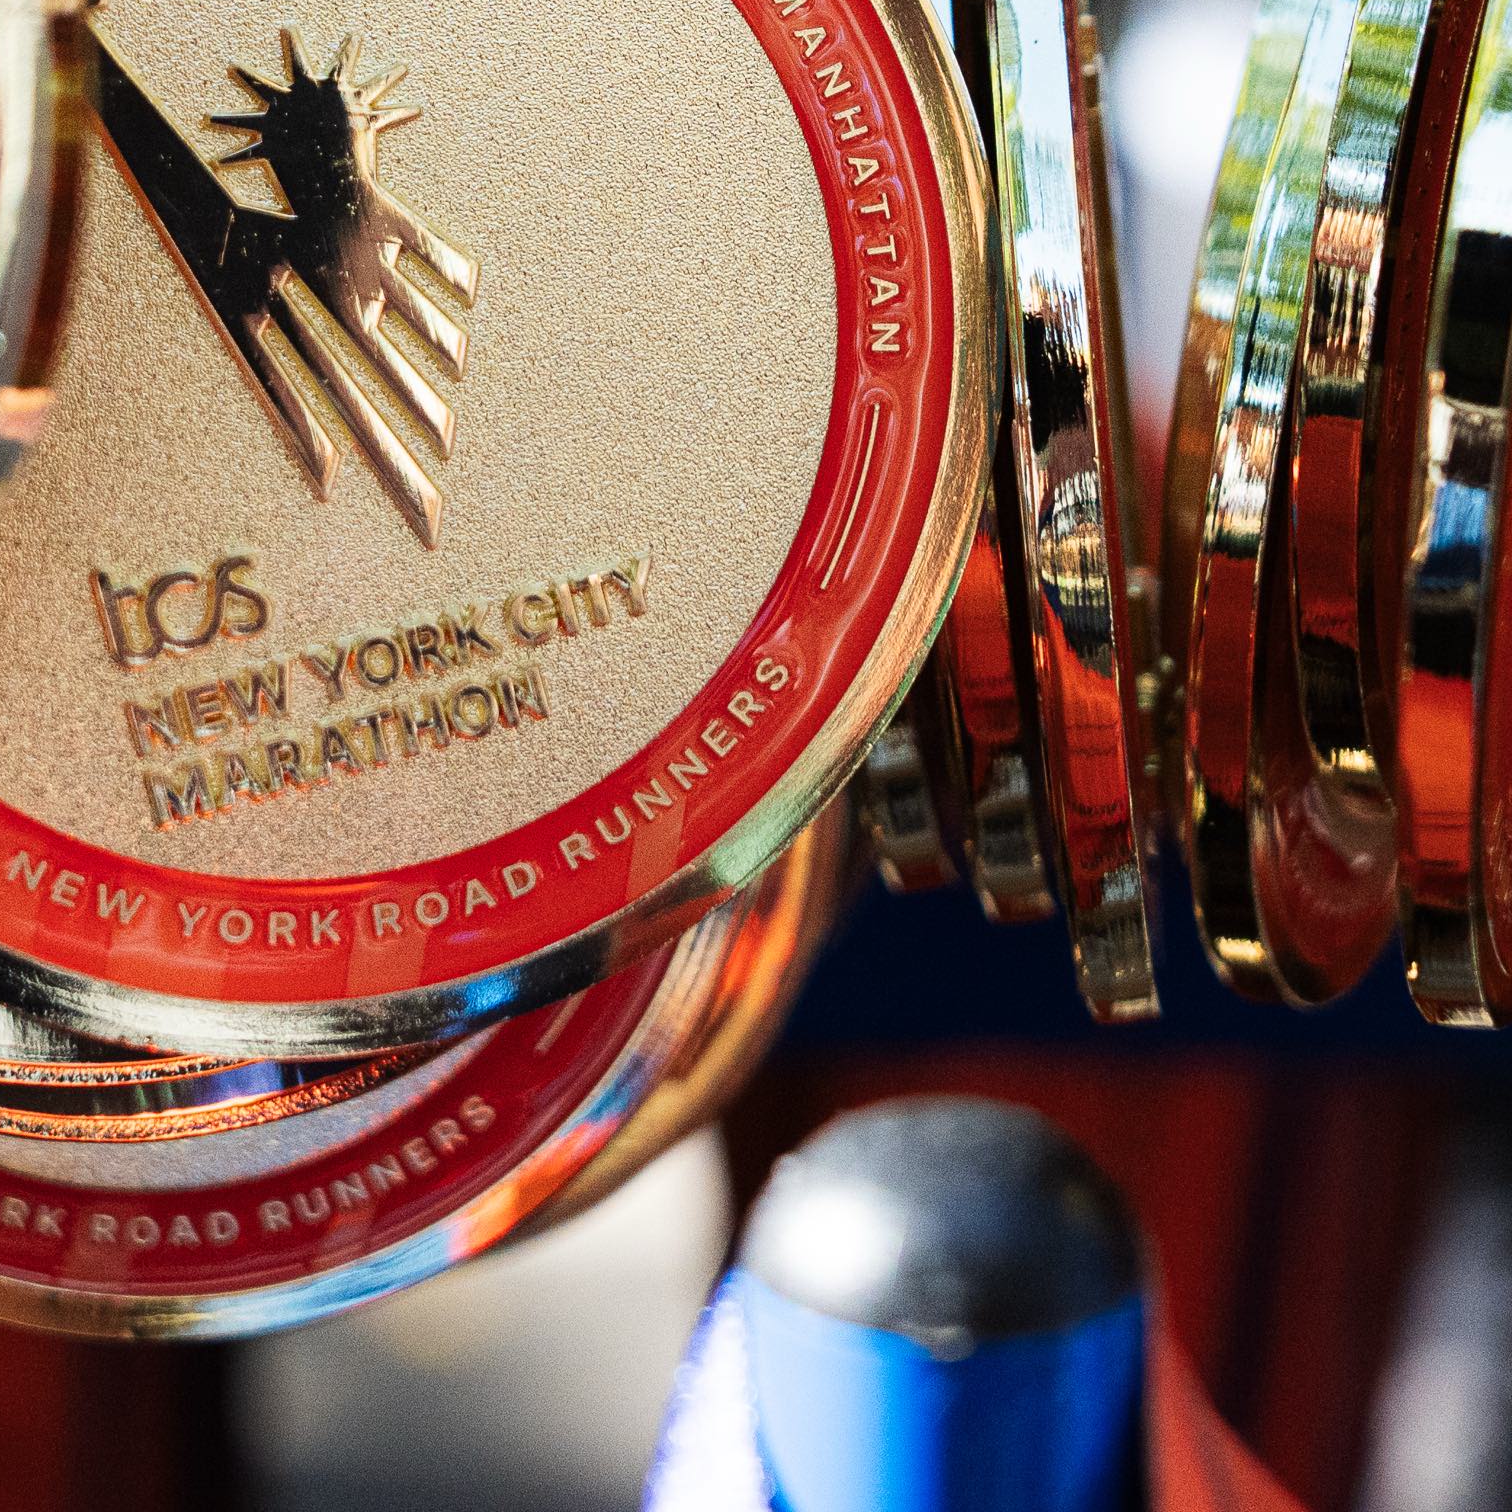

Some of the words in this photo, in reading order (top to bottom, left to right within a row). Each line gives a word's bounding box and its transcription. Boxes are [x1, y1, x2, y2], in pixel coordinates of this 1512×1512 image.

[88, 550, 272, 673] tcs
[122, 660, 294, 758] NEW
[306, 600, 492, 702] YORK
[502, 550, 655, 646] CITY
[4, 848, 148, 927] NEW
[177, 900, 342, 948] YORK
[370, 858, 542, 940] ROAD
[556, 653, 796, 872] RUNNERS
[142, 660, 552, 832] MARATHON
[89, 1207, 240, 1251] ROAD
[256, 1091, 499, 1234] RUNNERS
